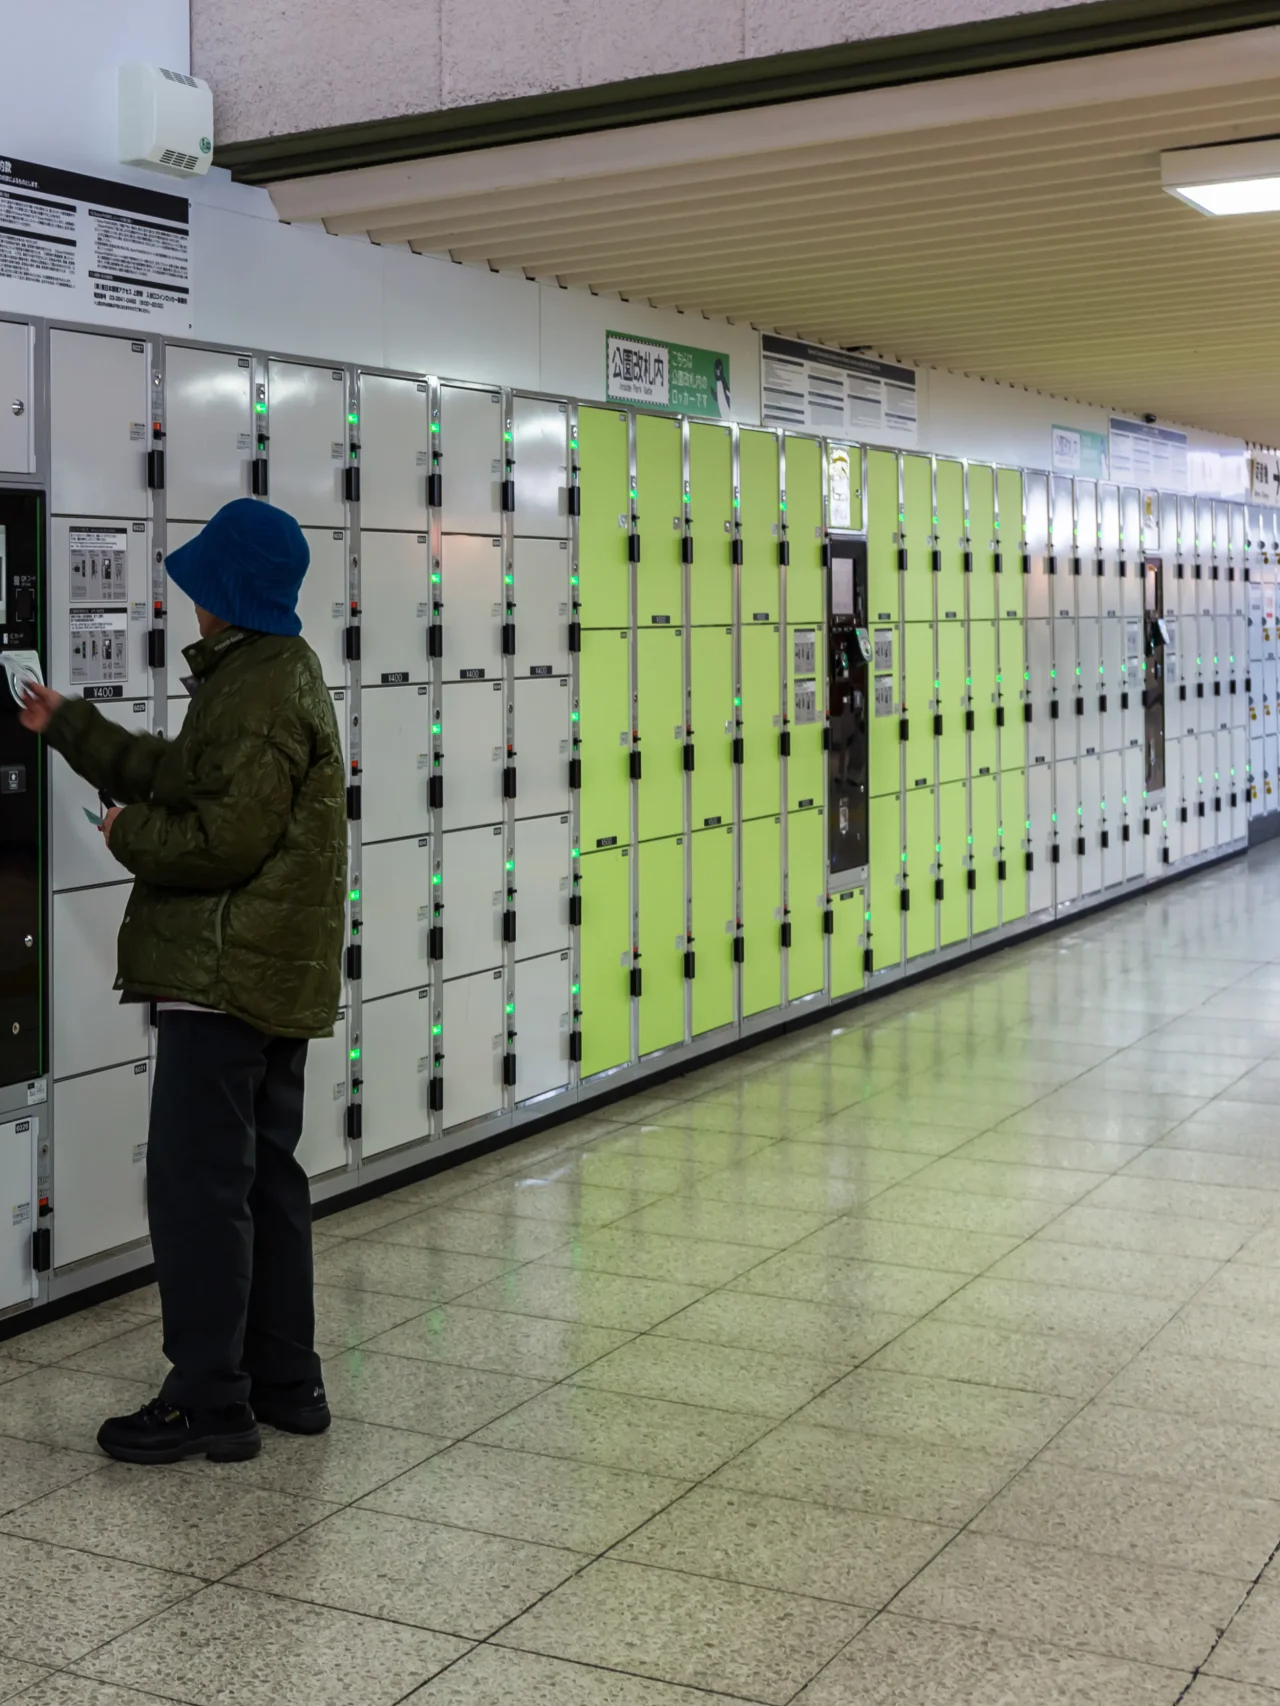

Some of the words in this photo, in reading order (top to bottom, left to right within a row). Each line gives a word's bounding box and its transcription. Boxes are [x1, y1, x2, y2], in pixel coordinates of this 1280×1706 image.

[612, 346, 664, 387] 公園改札内
[671, 351, 693, 369] こちらは
[671, 370, 708, 389] 公園改札内の
[672, 389, 708, 408] ロッカーです
[388, 674, 403, 682] ¥400
[93, 687, 113, 697] ¥400
